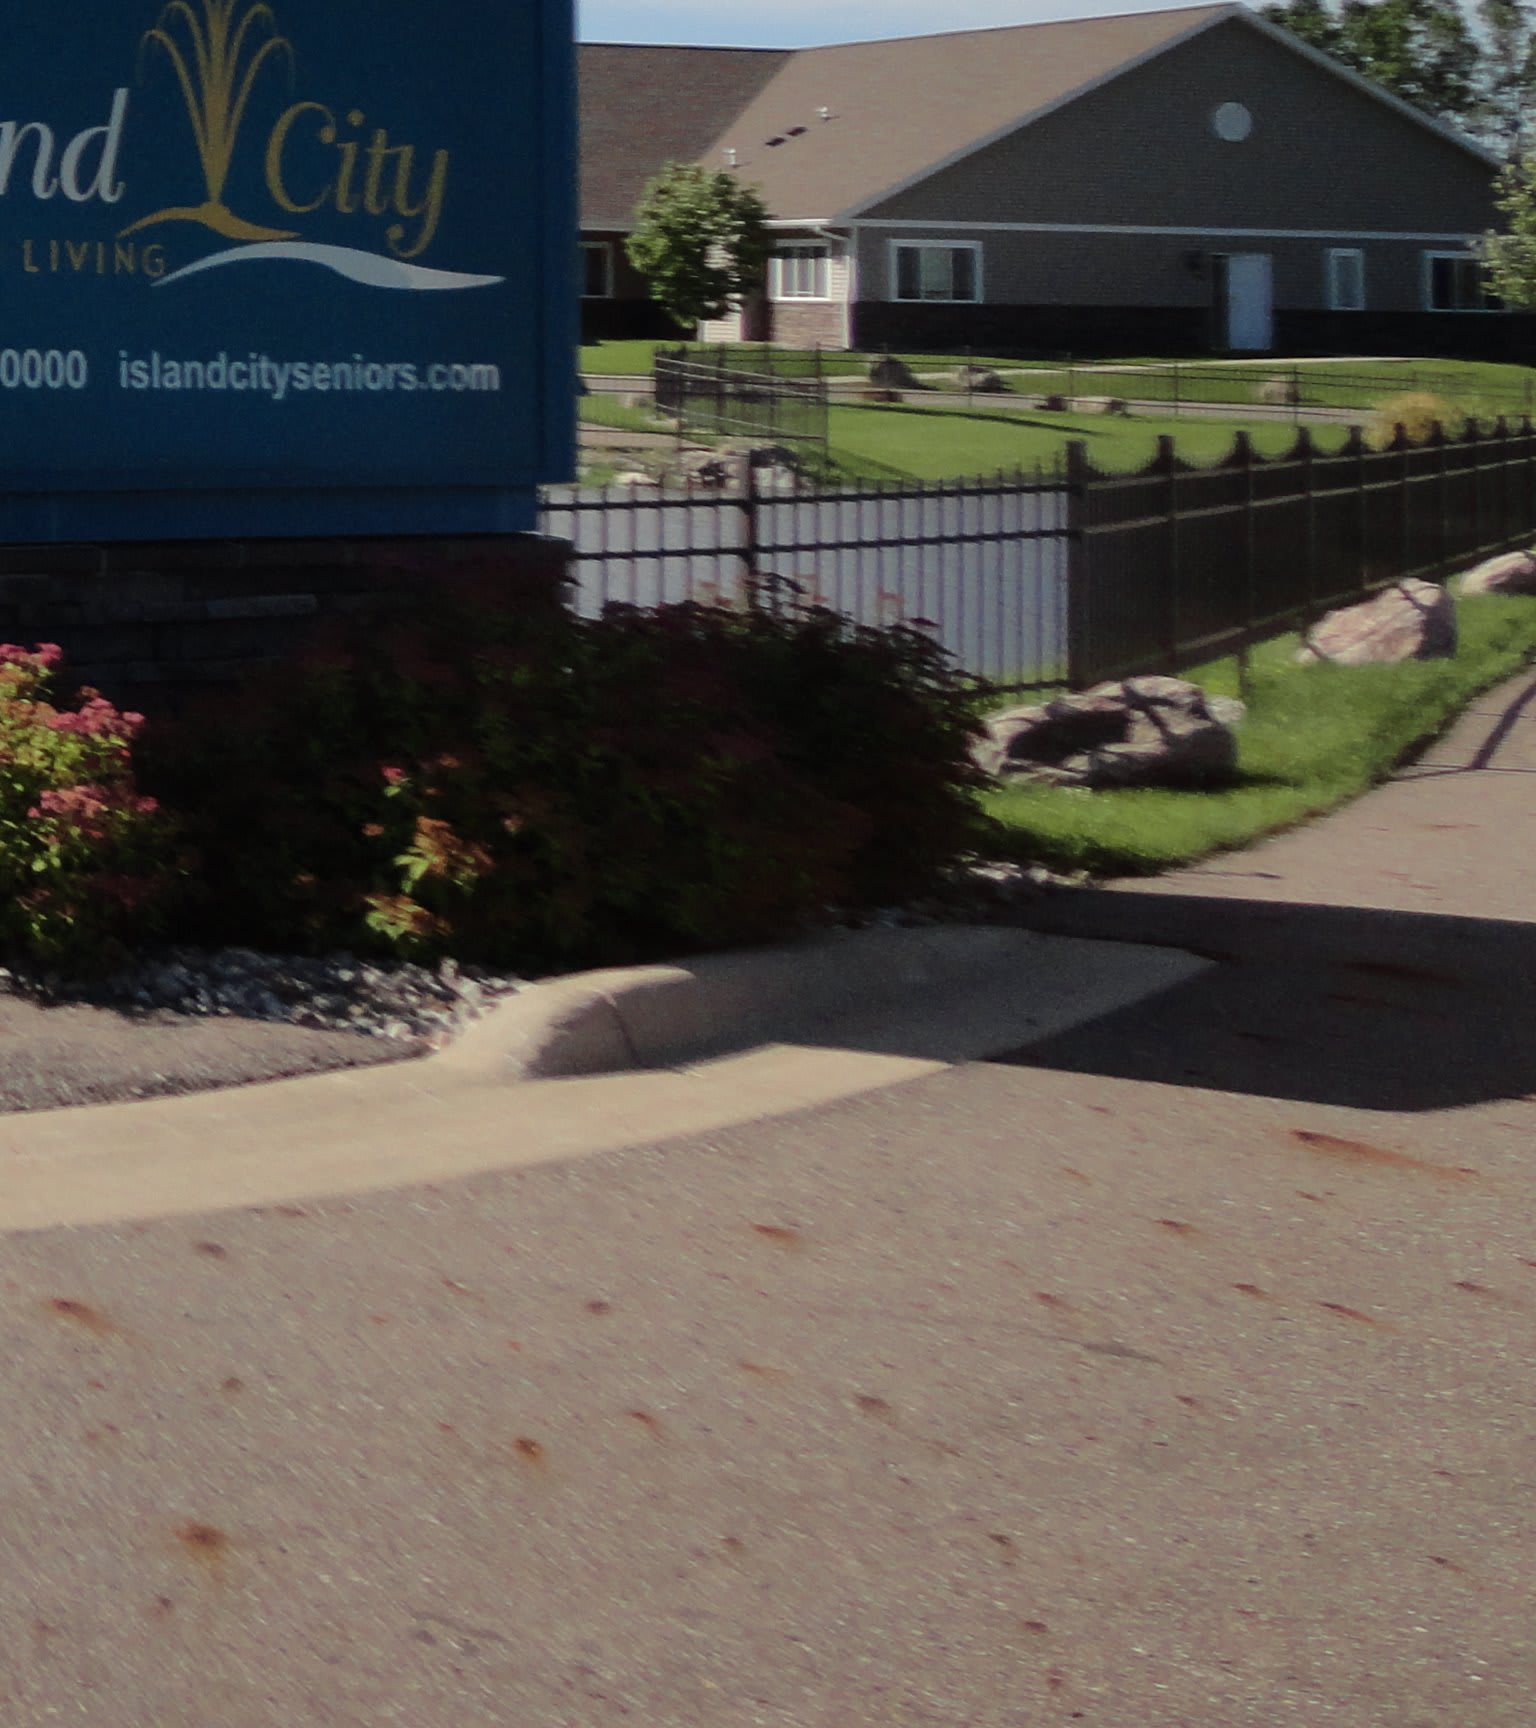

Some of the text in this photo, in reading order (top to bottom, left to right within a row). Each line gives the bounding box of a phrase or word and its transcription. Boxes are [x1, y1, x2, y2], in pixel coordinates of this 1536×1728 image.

[265, 101, 449, 258] City
[22, 238, 167, 278] LIVING
[118, 350, 501, 400] islandcityseniors.com
